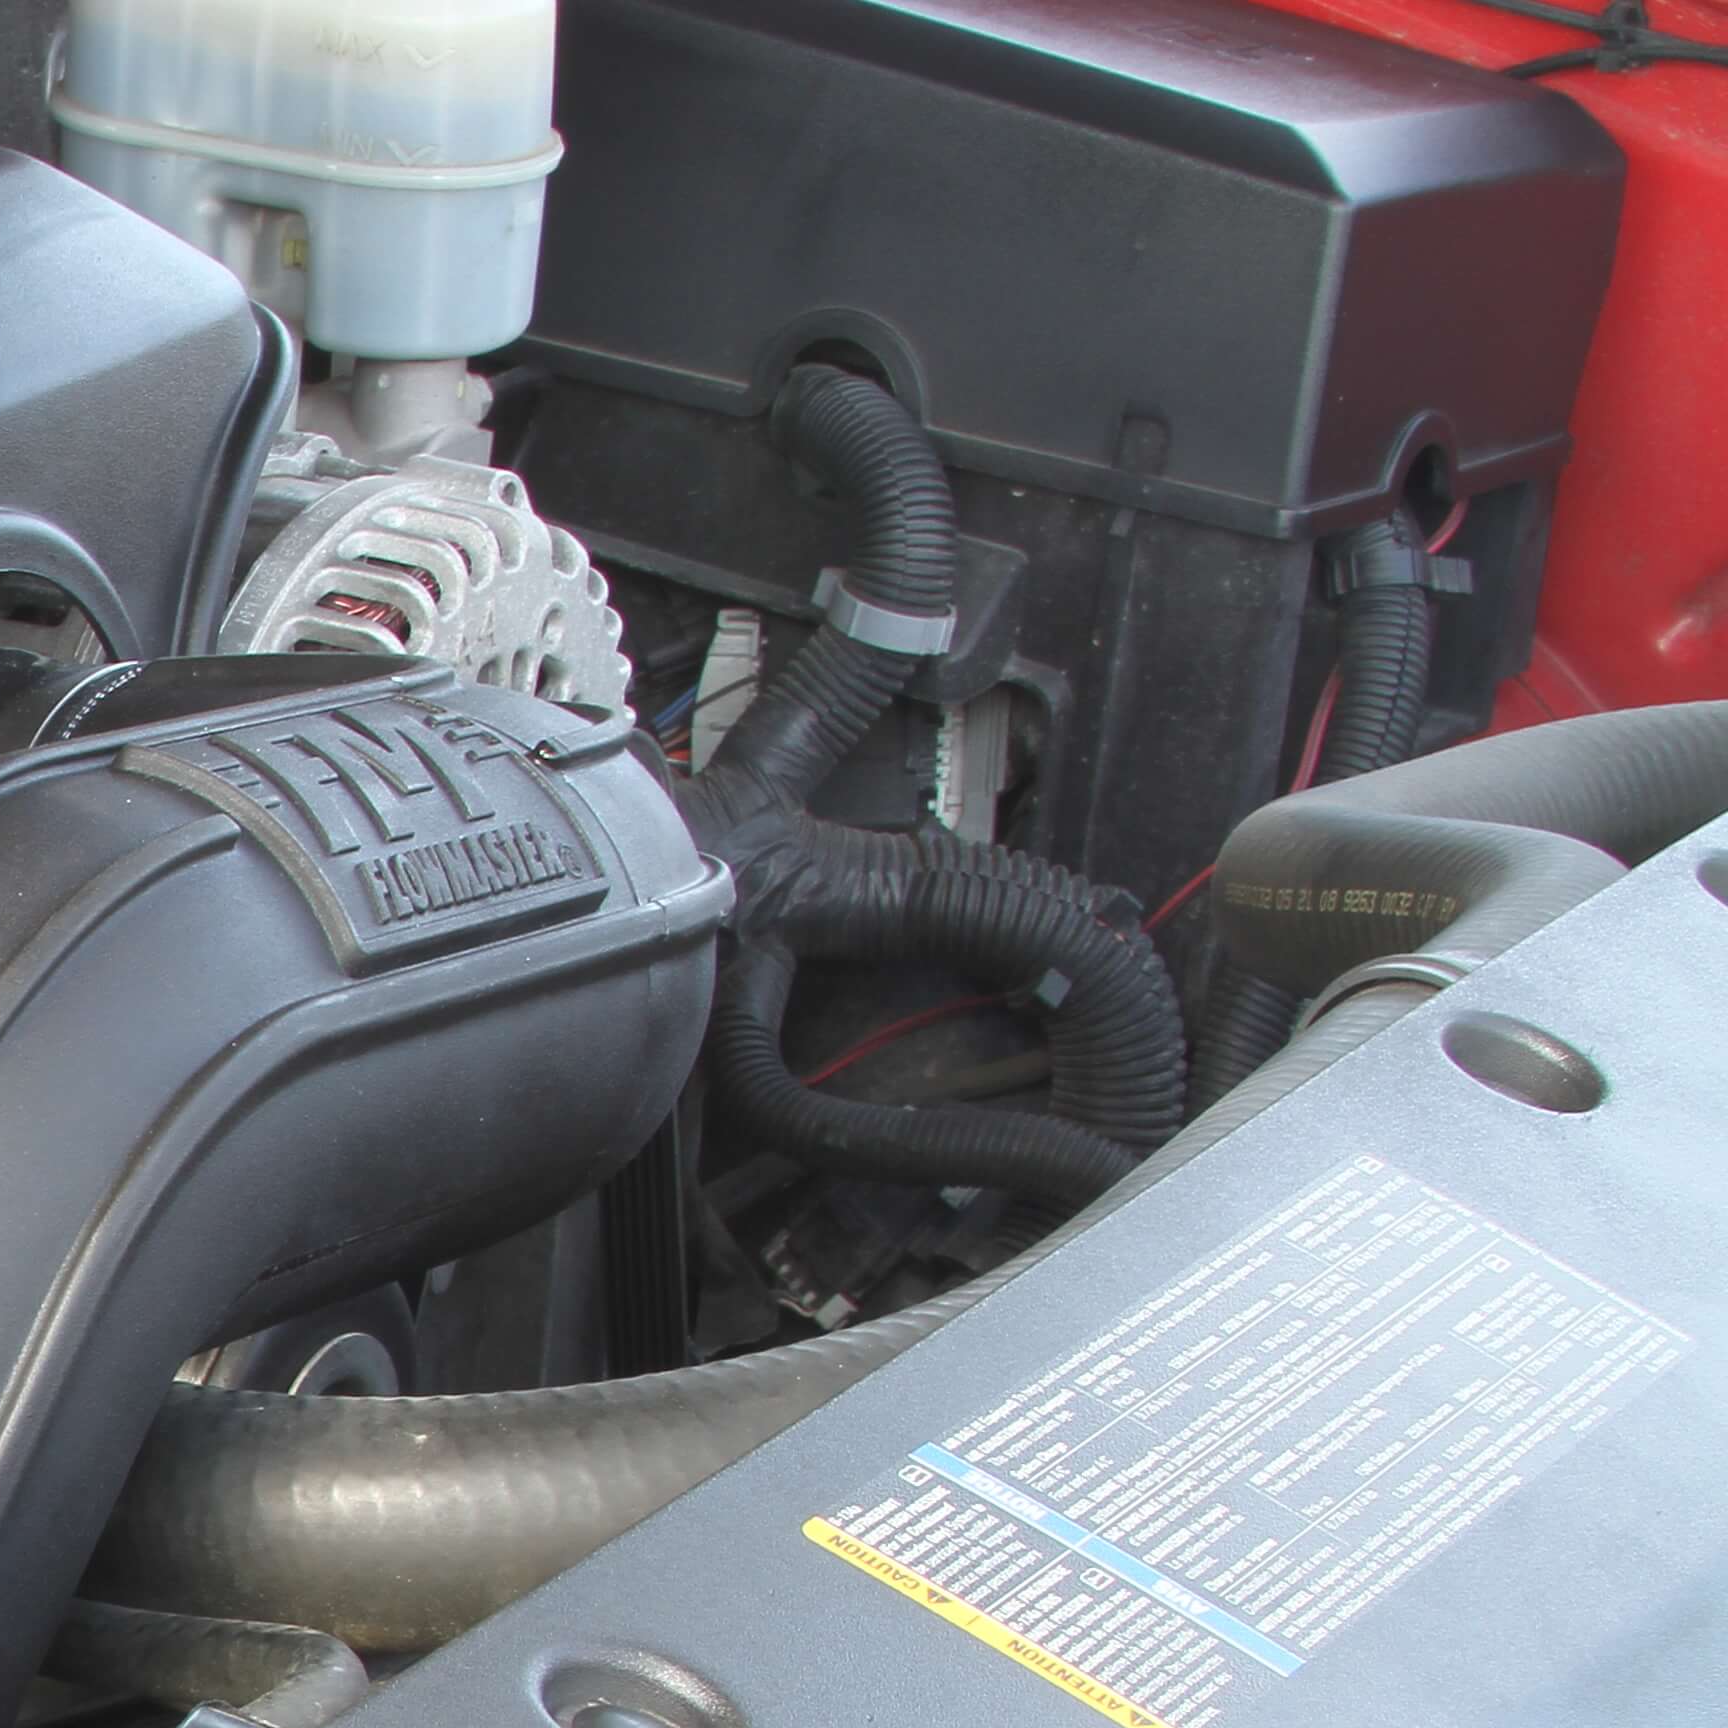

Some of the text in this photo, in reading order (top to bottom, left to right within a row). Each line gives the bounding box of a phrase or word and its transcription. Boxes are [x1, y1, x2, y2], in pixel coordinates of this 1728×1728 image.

[354, 820, 568, 926] FLOWMASTER
[958, 1468, 1048, 1521] NOTICE
[827, 1533, 922, 1591] CAUTION
[1150, 1578, 1213, 1617] AVIS
[1006, 1637, 1127, 1713] ATTENTION
